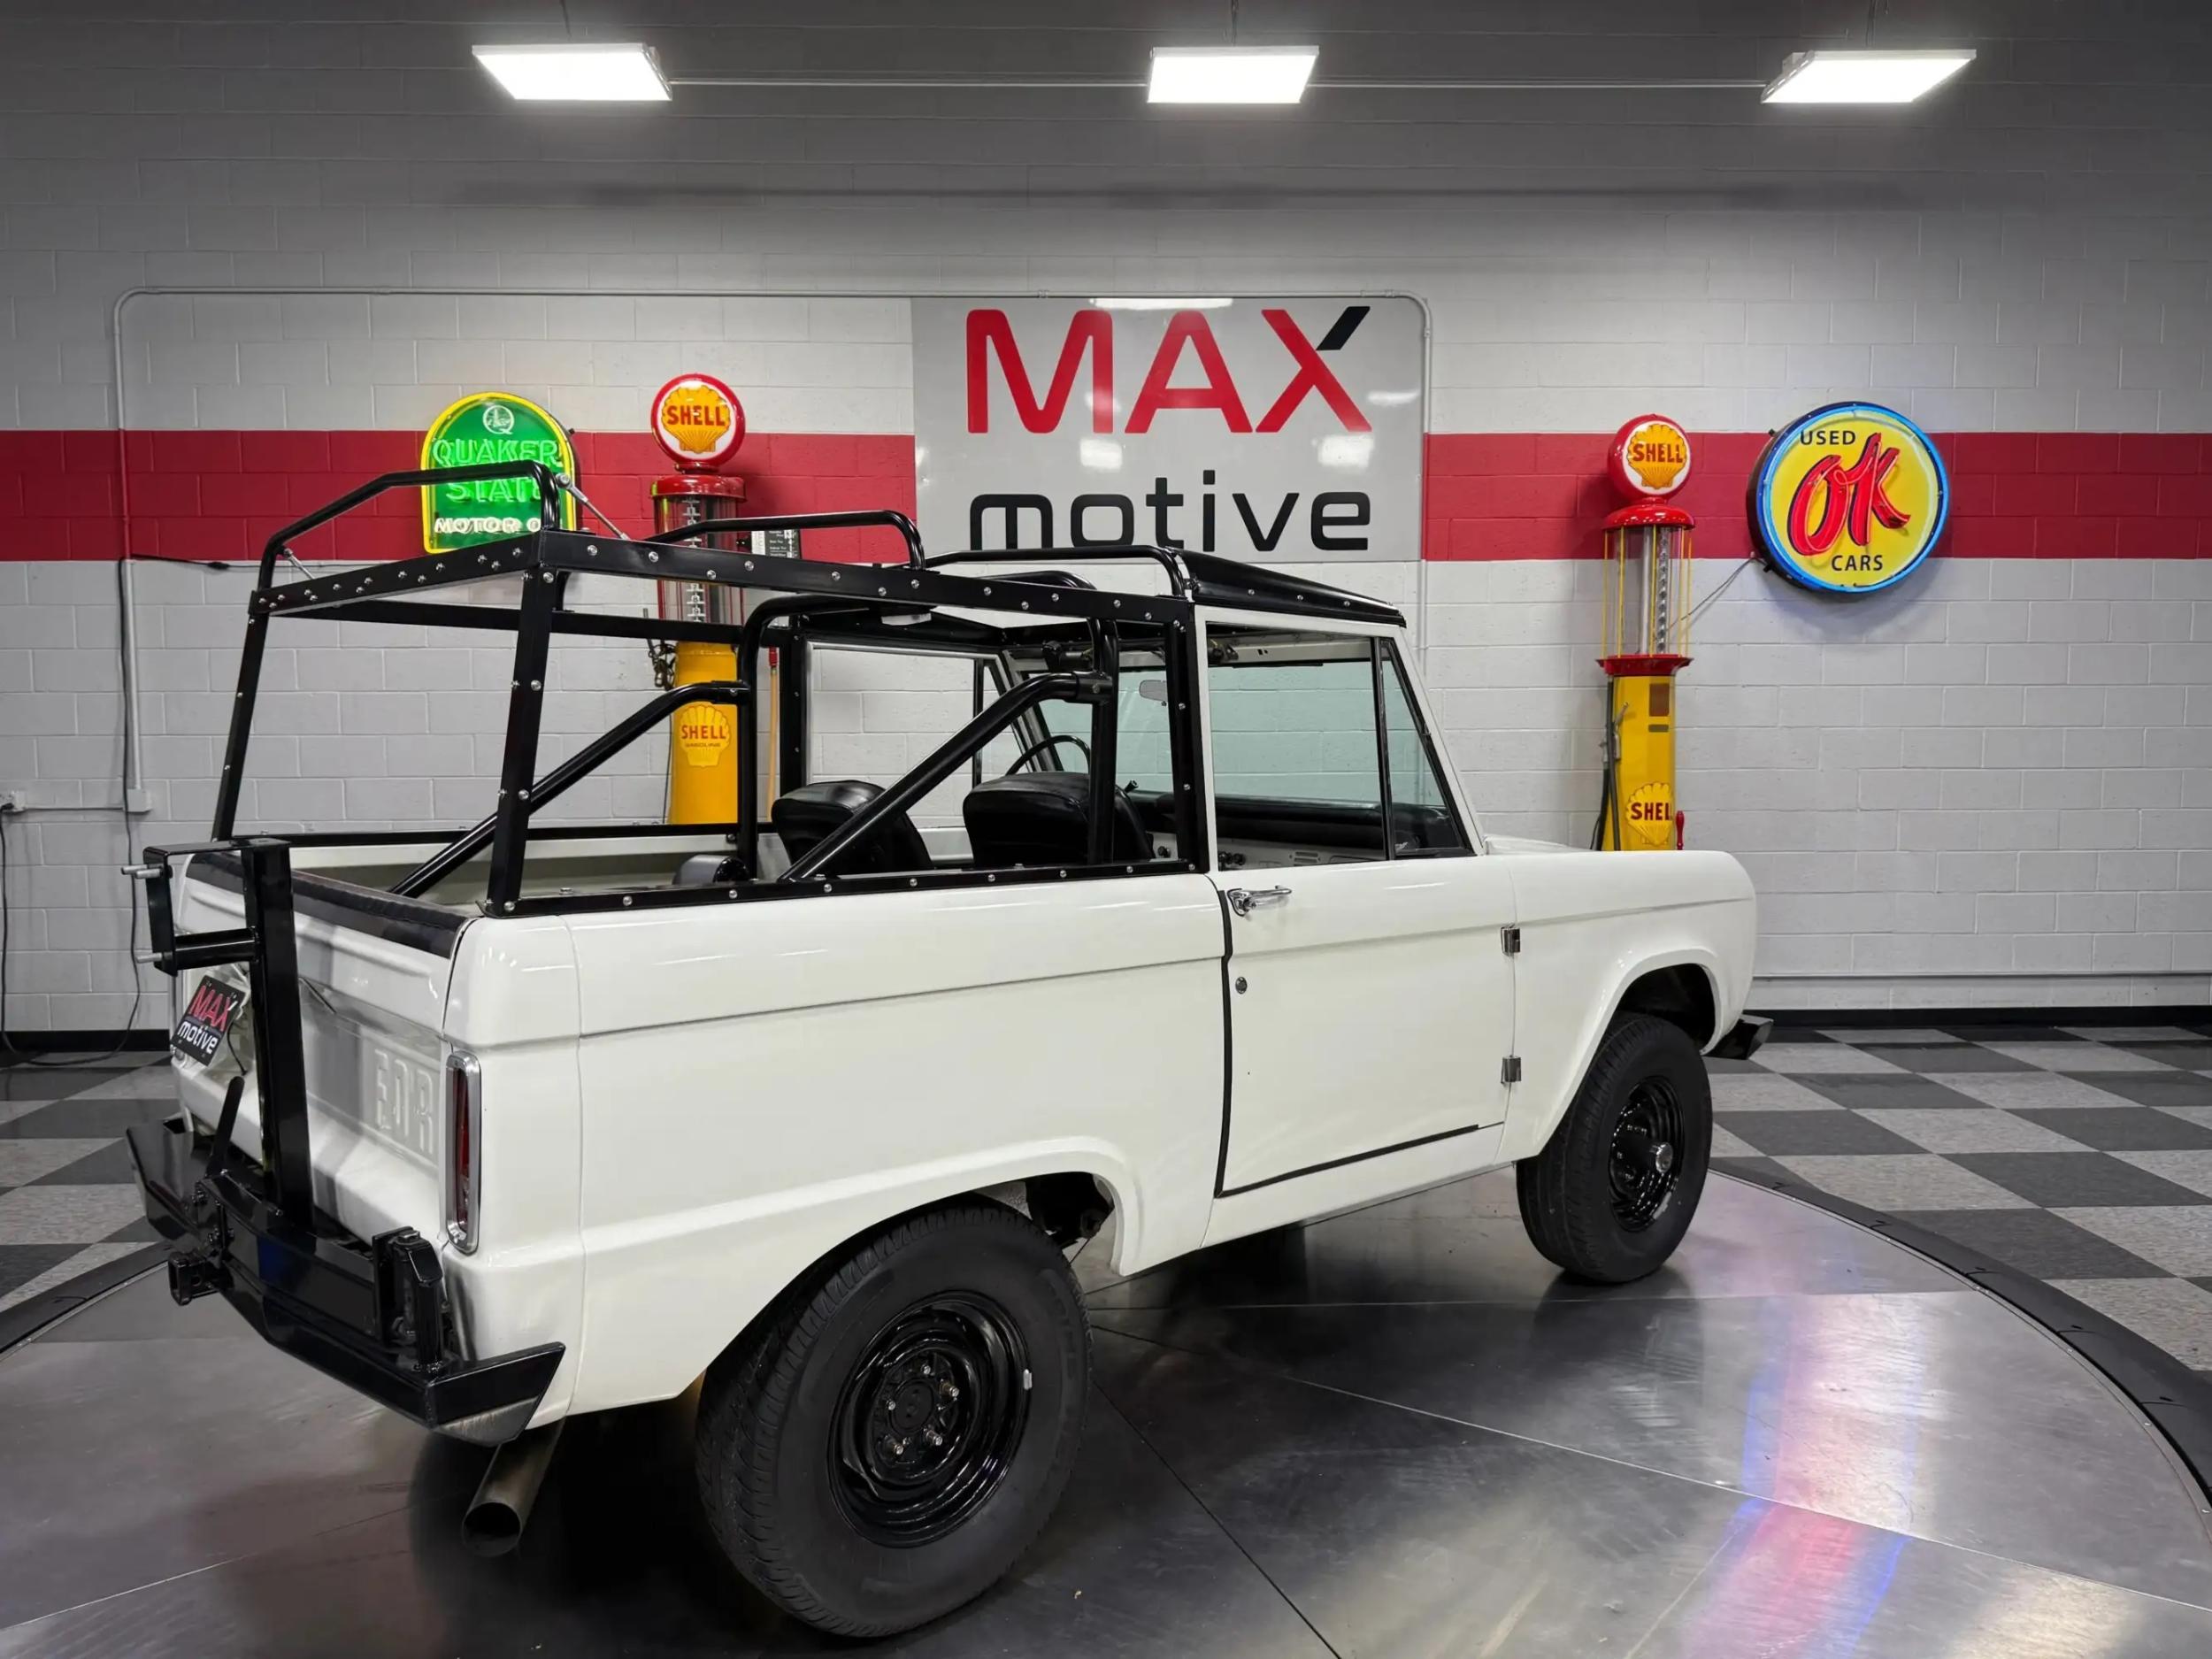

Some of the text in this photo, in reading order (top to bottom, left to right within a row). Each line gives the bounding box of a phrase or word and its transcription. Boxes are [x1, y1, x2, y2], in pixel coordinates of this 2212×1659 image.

[966, 306, 1372, 434] MAX
[666, 404, 726, 427] SHELL
[1801, 430, 1855, 446] USED
[432, 438, 564, 467] QUAKER
[1632, 442, 1684, 464] SHELL
[1787, 433, 1910, 557] OK
[970, 470, 1371, 551] motive
[434, 517, 522, 534] MOTOR
[1831, 555, 1884, 572] CARS
[681, 725, 726, 740] SHELL
[1631, 802, 1672, 821] SHEL
[188, 985, 238, 1033] MAX
[177, 1020, 219, 1055] motive
